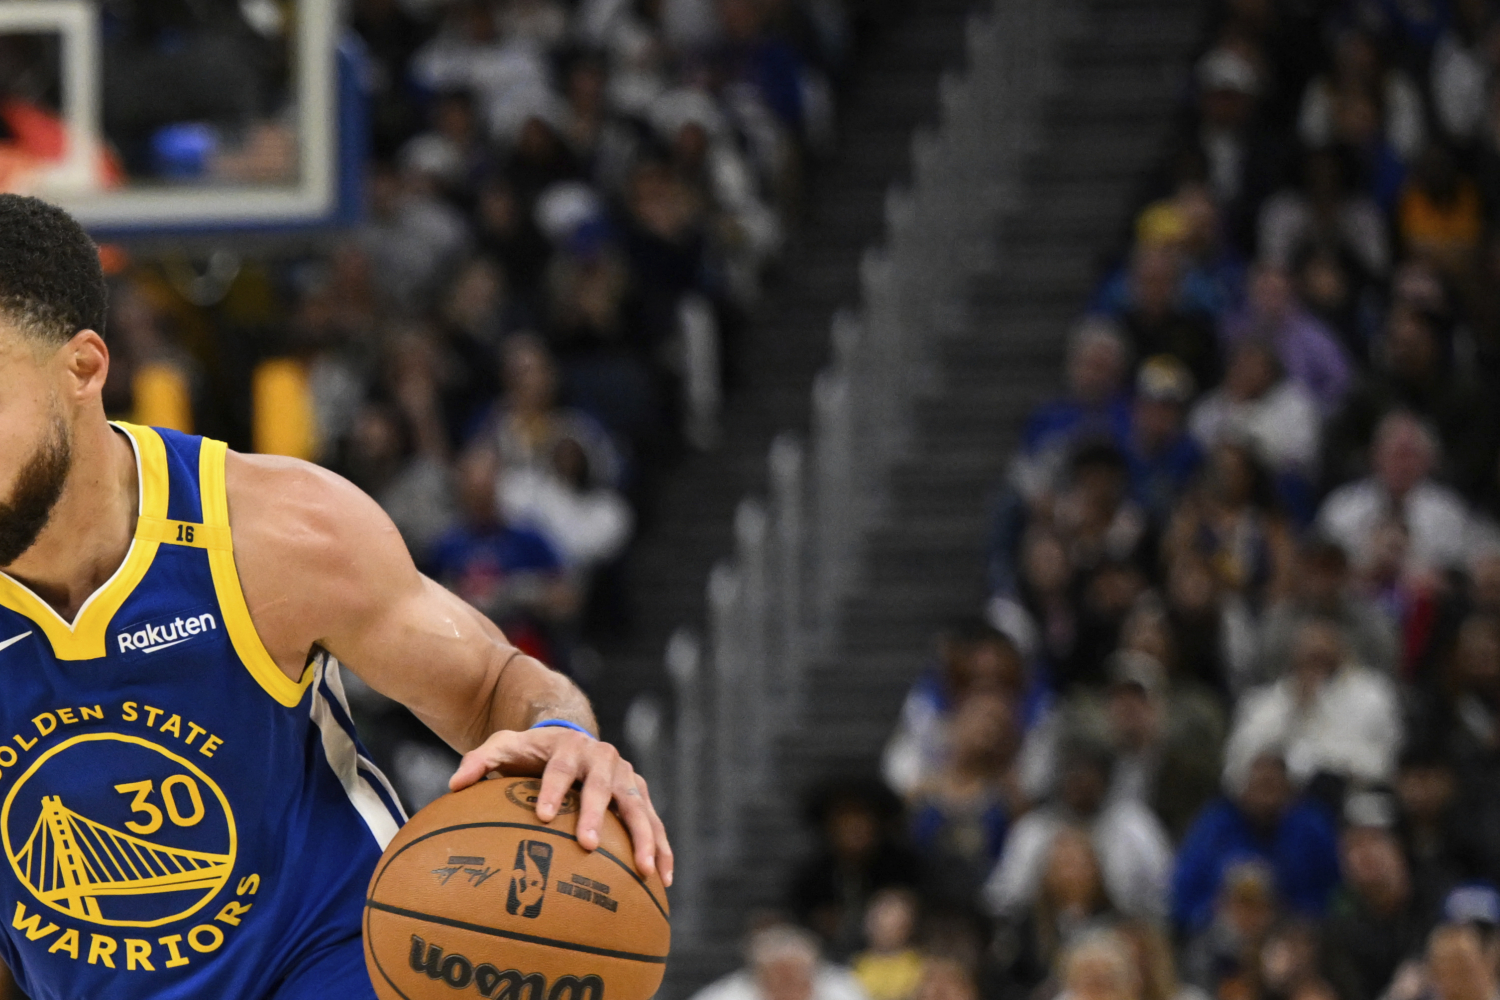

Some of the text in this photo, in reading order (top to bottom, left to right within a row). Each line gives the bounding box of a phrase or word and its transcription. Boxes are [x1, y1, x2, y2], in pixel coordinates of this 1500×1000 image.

[176, 524, 195, 543] 16
[117, 612, 217, 654] Rakuten
[121, 701, 224, 758] STATE
[114, 774, 205, 835] 30
[11, 872, 261, 971] WARRIORS
